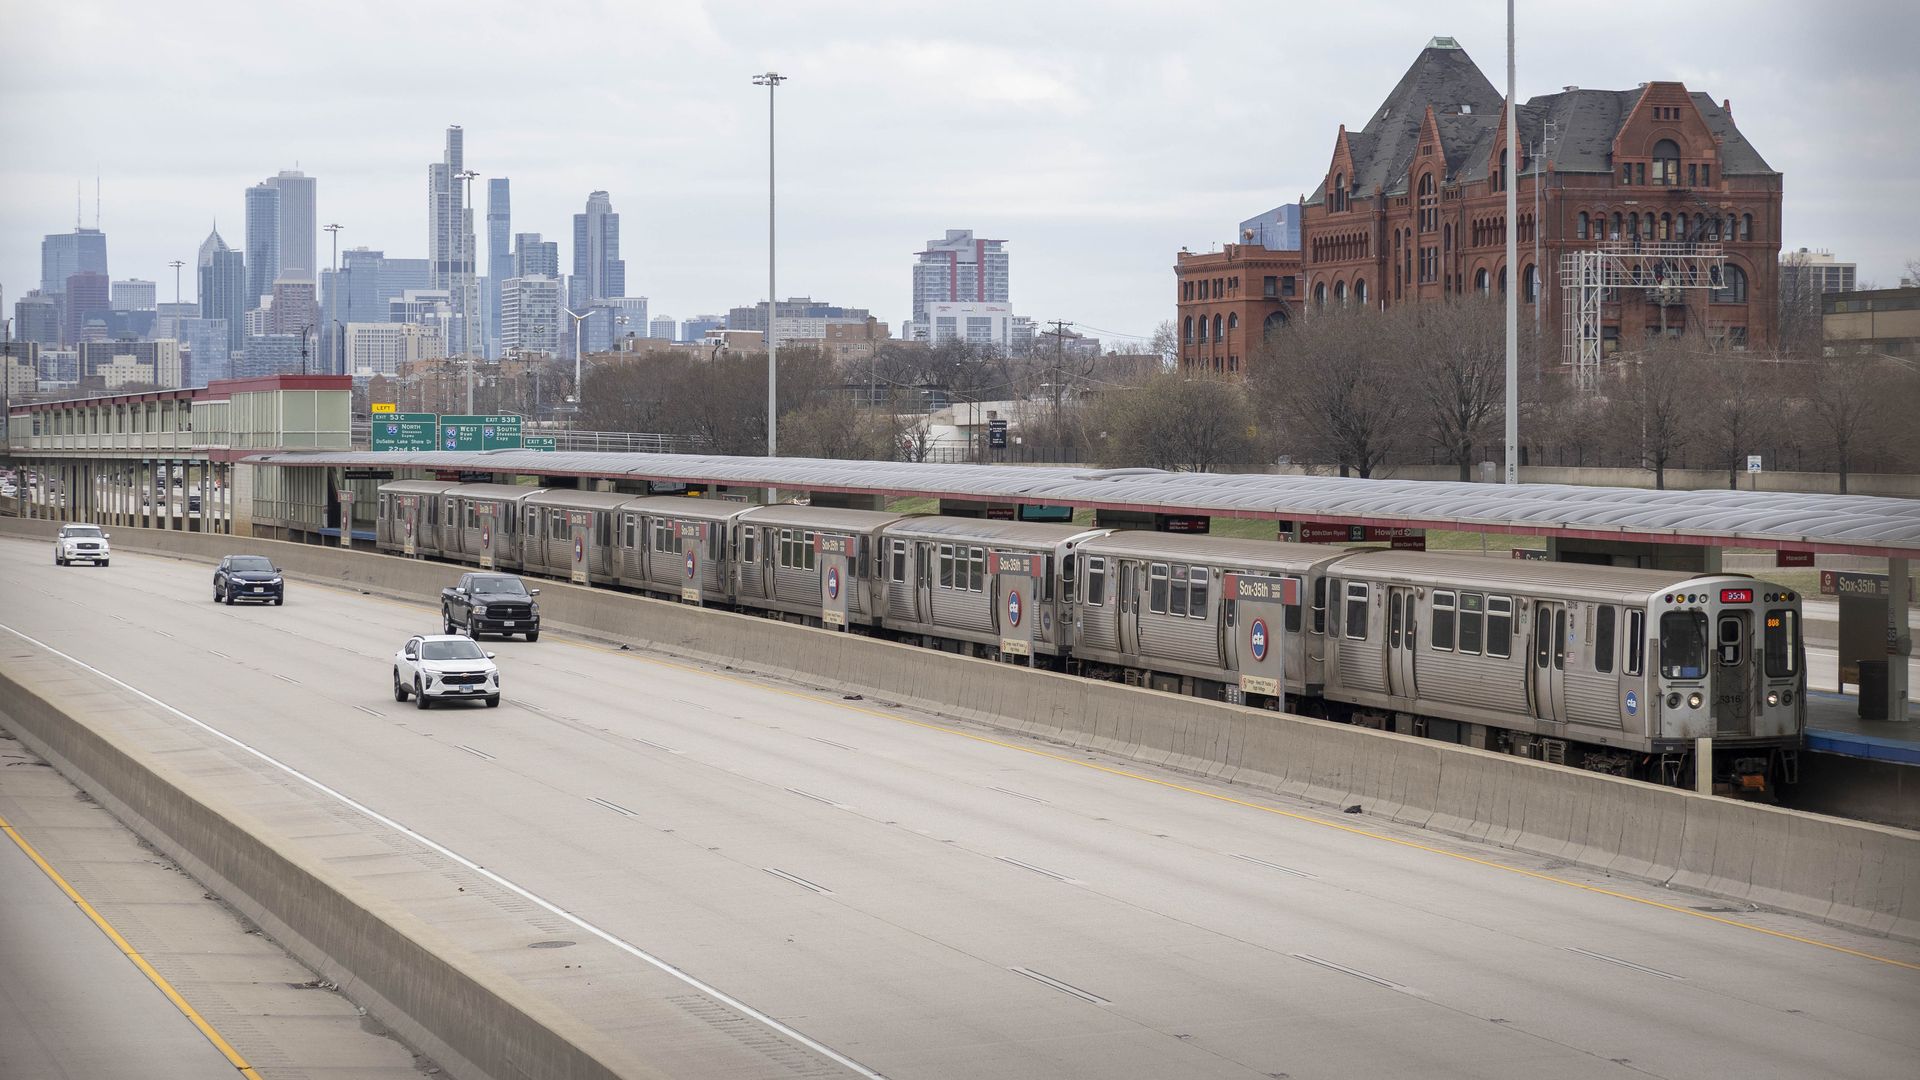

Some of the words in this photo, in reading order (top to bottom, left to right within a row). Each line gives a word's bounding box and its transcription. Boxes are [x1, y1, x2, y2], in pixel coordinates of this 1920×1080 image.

[1000, 557, 1020, 571] Sox-35th
[1240, 580, 1268, 597] Sox-35th
[1840, 577, 1876, 593] Sox-35th
[1010, 602, 1018, 613] cta
[1252, 632, 1264, 645] cta
[1627, 698, 1636, 707] cta
[1720, 695, 1741, 704] 5316
